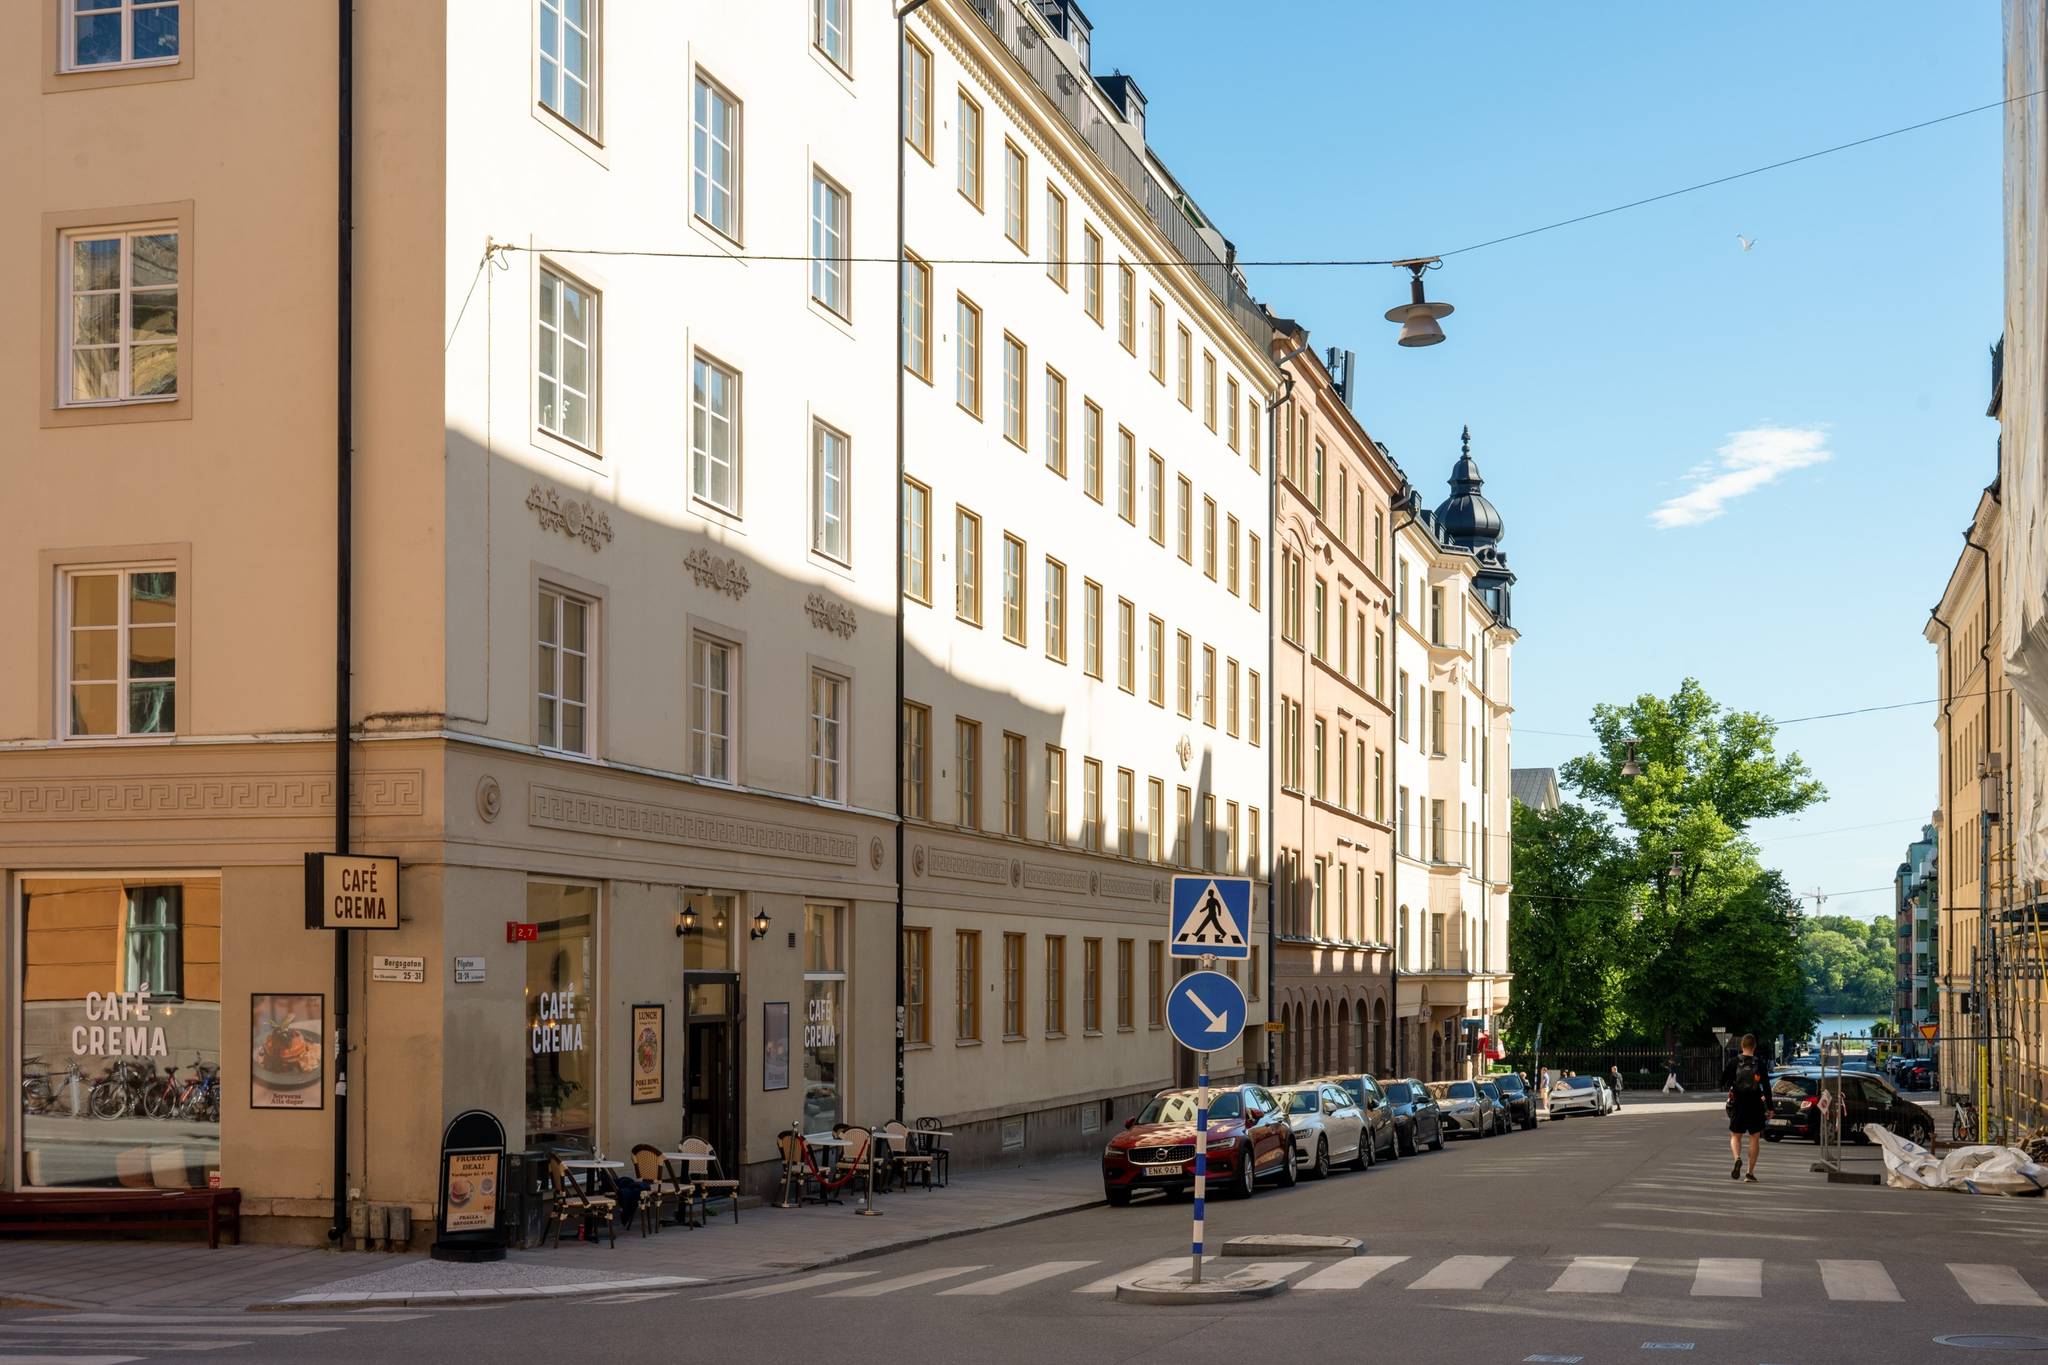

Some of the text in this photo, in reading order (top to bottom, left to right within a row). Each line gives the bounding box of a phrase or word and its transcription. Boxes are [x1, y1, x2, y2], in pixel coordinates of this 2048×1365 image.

[342, 863, 377, 892] CAFÉ
[335, 895, 386, 919] CREMA
[384, 958, 422, 970] Bergsgatan
[86, 981, 151, 1021] CAFÉ
[540, 982, 575, 1020] CAFÉ
[639, 1011, 657, 1020] LUNCH
[809, 992, 833, 1021] CAFÉ
[72, 1026, 168, 1056] CREMA
[532, 1023, 583, 1054] CREMA
[804, 1024, 836, 1048] CREMA
